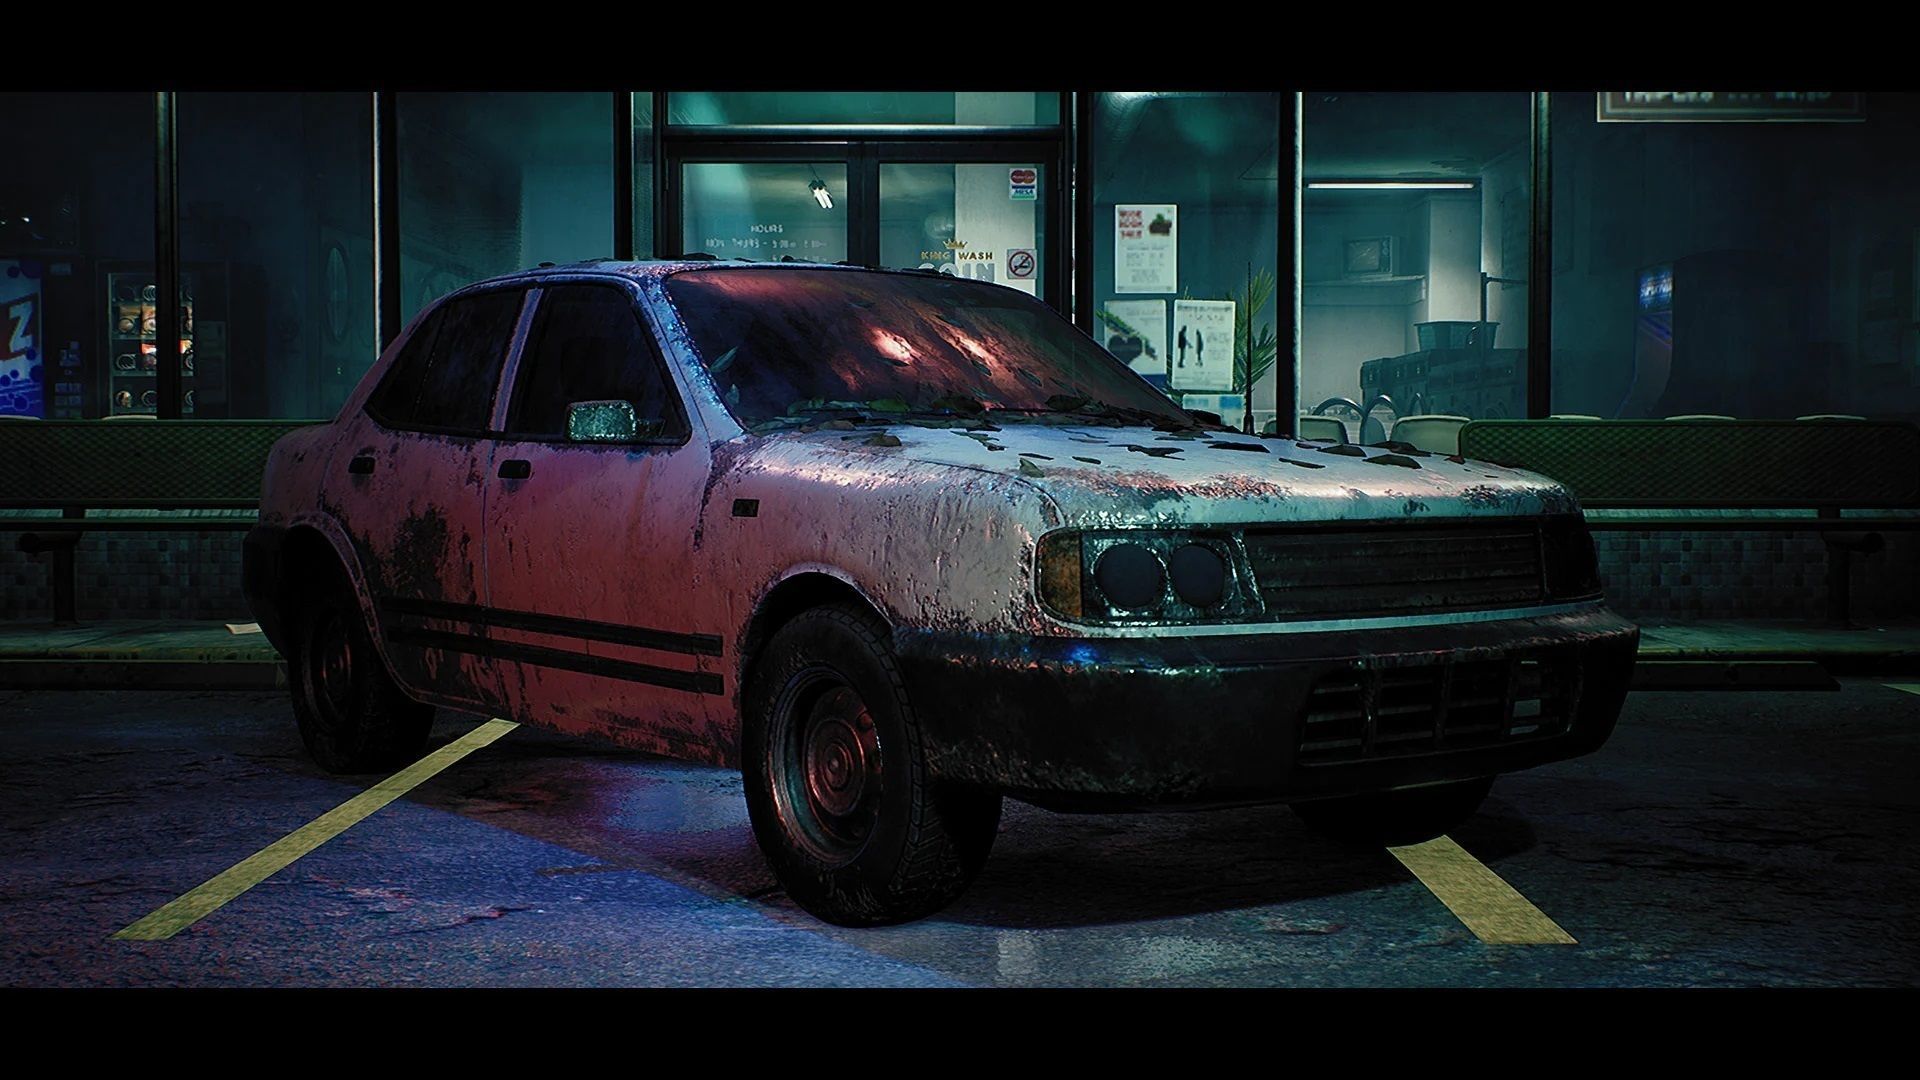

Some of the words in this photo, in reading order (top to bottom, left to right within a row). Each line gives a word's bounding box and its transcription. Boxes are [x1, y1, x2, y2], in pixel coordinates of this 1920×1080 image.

[750, 224, 784, 234] HOURS
[921, 252, 950, 260] KING
[958, 252, 993, 260] WASH
